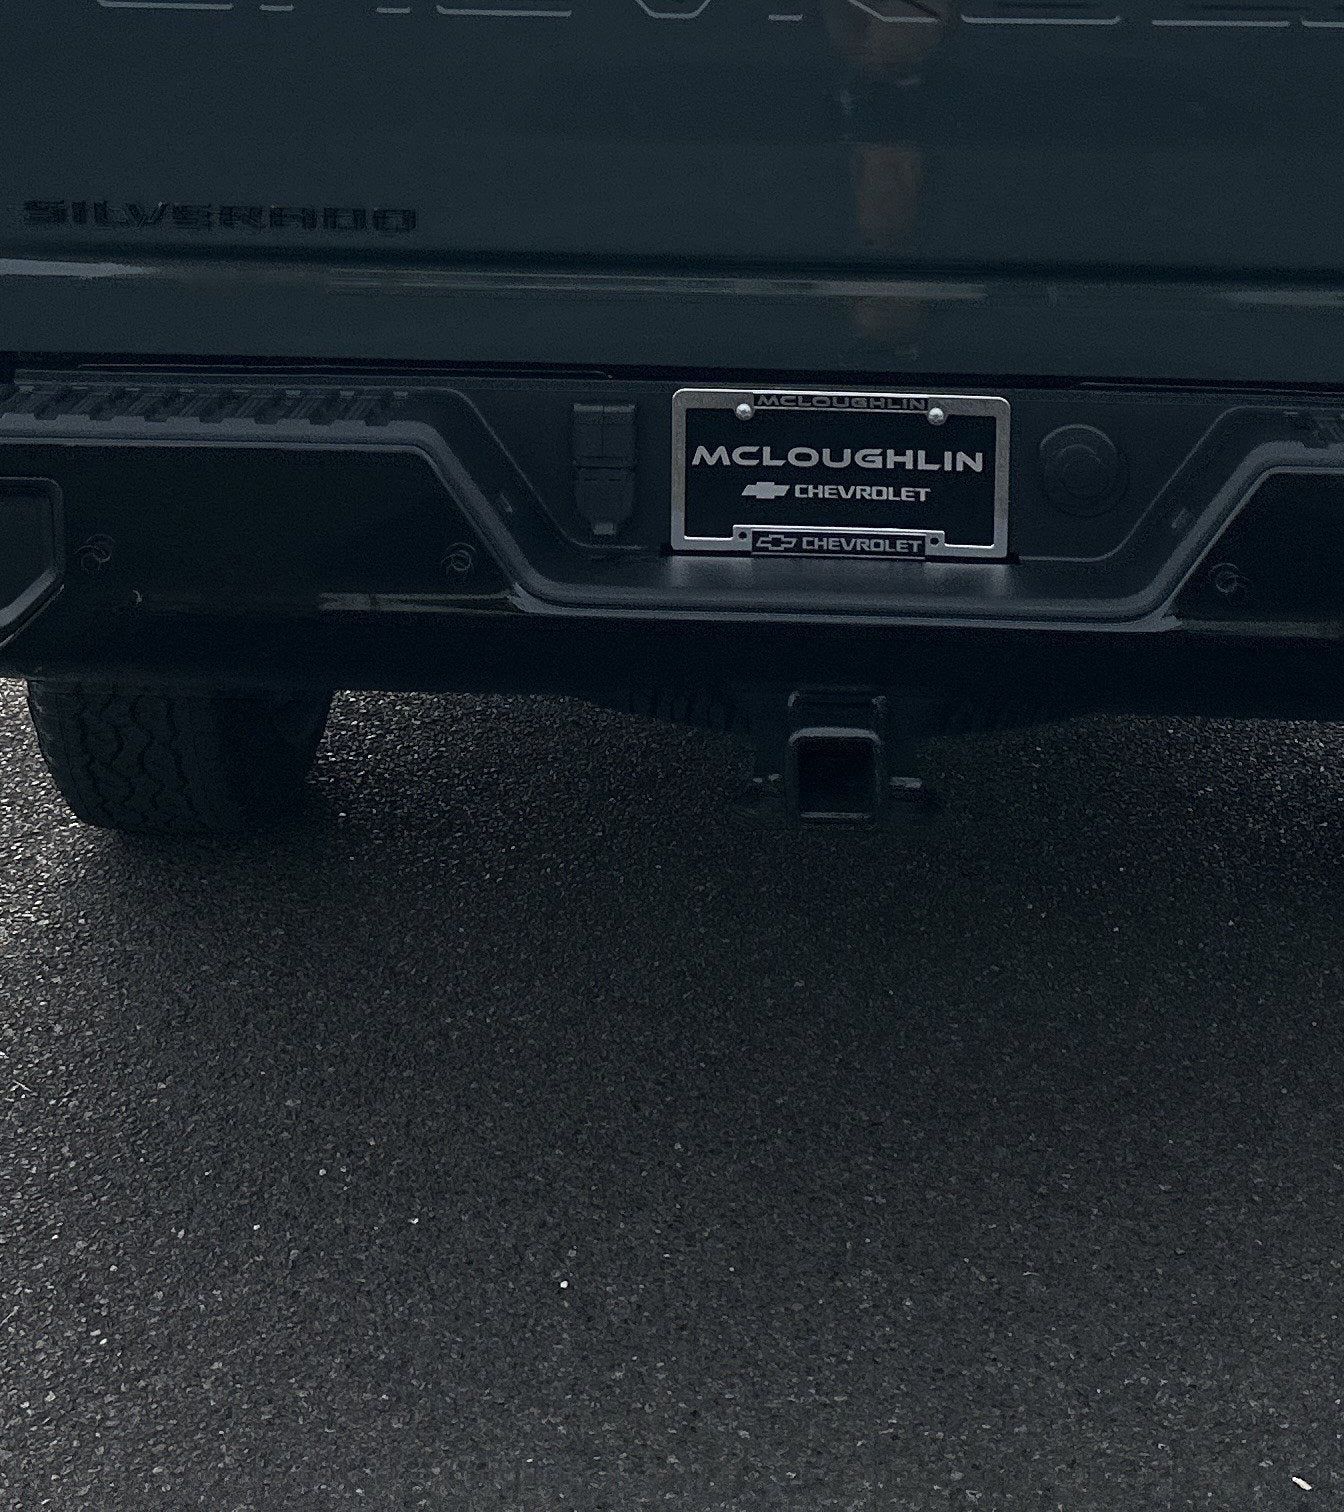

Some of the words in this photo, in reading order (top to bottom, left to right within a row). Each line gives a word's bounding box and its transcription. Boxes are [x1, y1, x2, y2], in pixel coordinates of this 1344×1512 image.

[23, 199, 417, 234] SILVERADO
[757, 394, 928, 410] MCLOUGHLIN
[691, 445, 984, 473] MCLOUGHLIN
[794, 484, 932, 502] CHEVROLET
[801, 537, 923, 553] CHEVROLET
